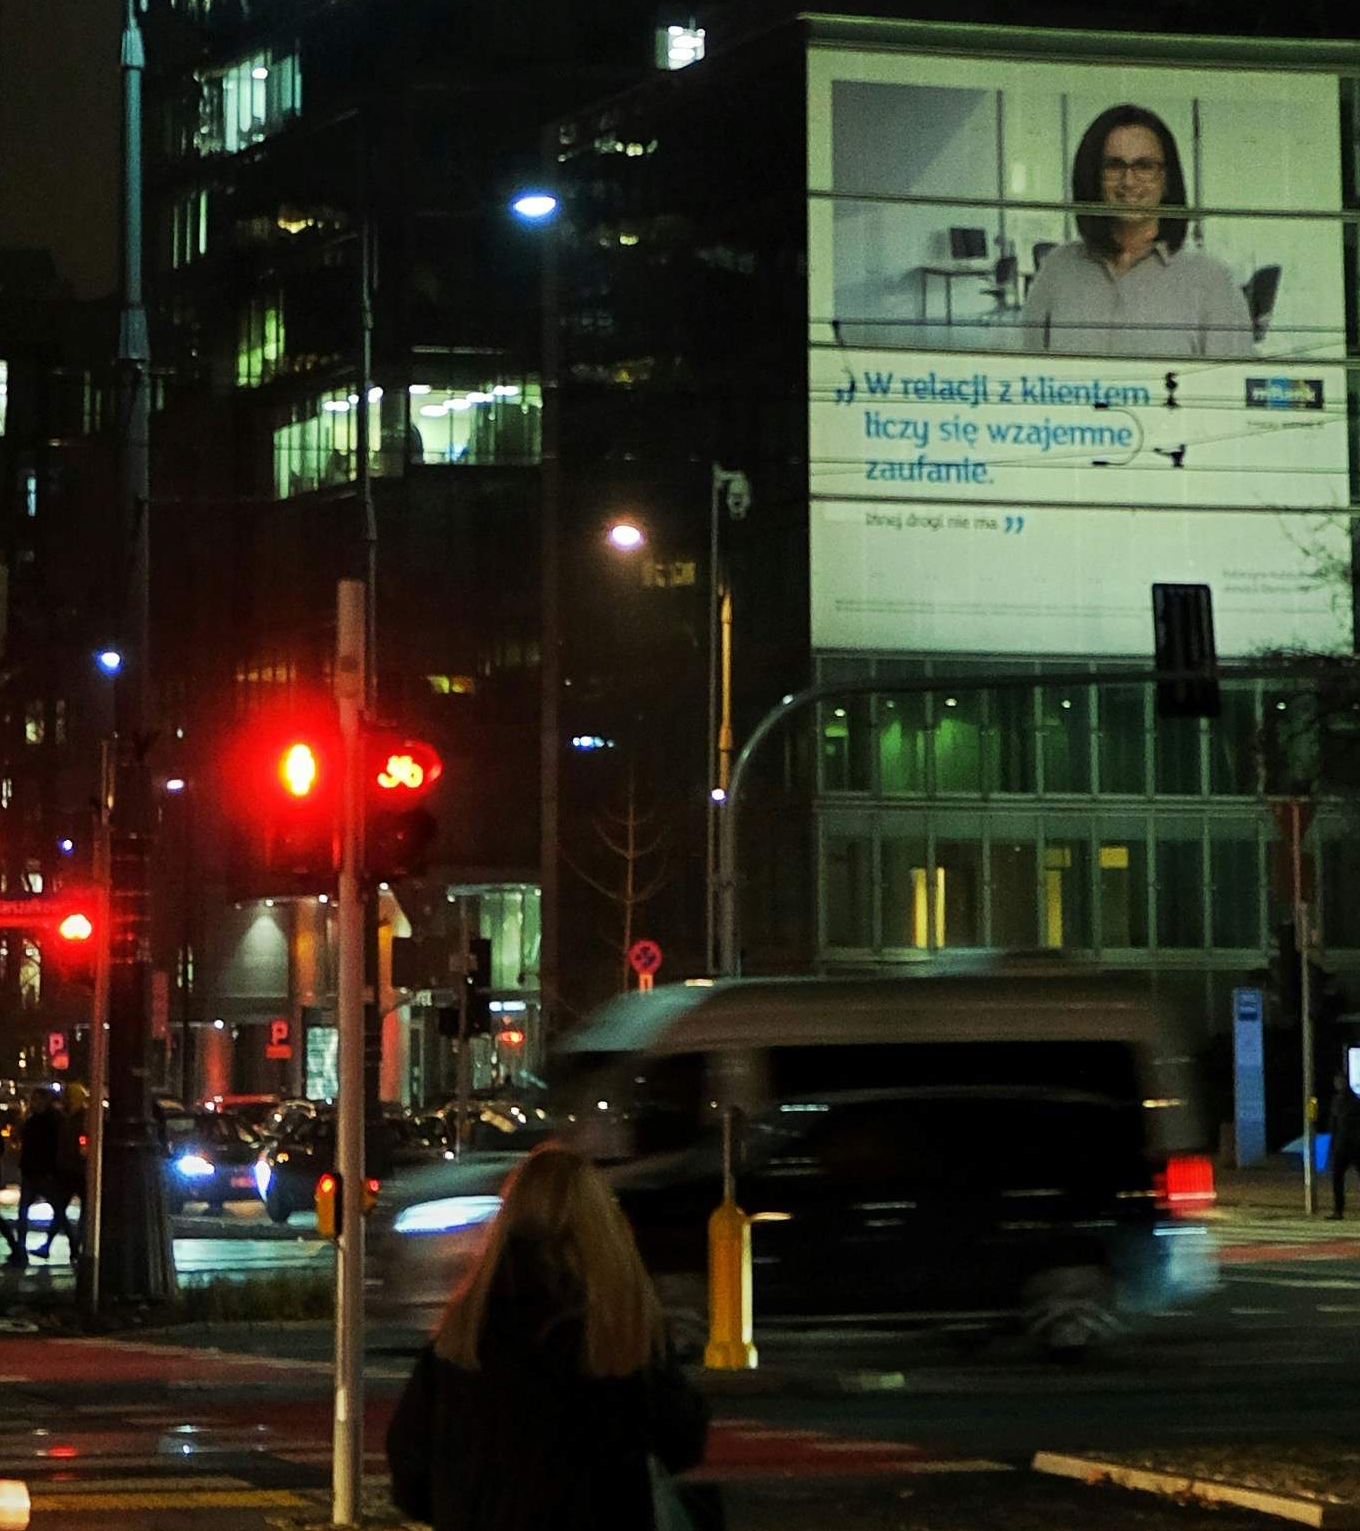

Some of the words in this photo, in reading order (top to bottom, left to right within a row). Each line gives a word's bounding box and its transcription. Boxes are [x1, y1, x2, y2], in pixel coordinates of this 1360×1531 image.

[902, 372, 989, 407] relacji
[998, 380, 1013, 402] z
[1020, 376, 1150, 406] klientem
[864, 412, 929, 448] liczy
[940, 415, 979, 447] się
[986, 418, 1133, 451] wzajemne
[864, 455, 994, 484] zaufanie.
